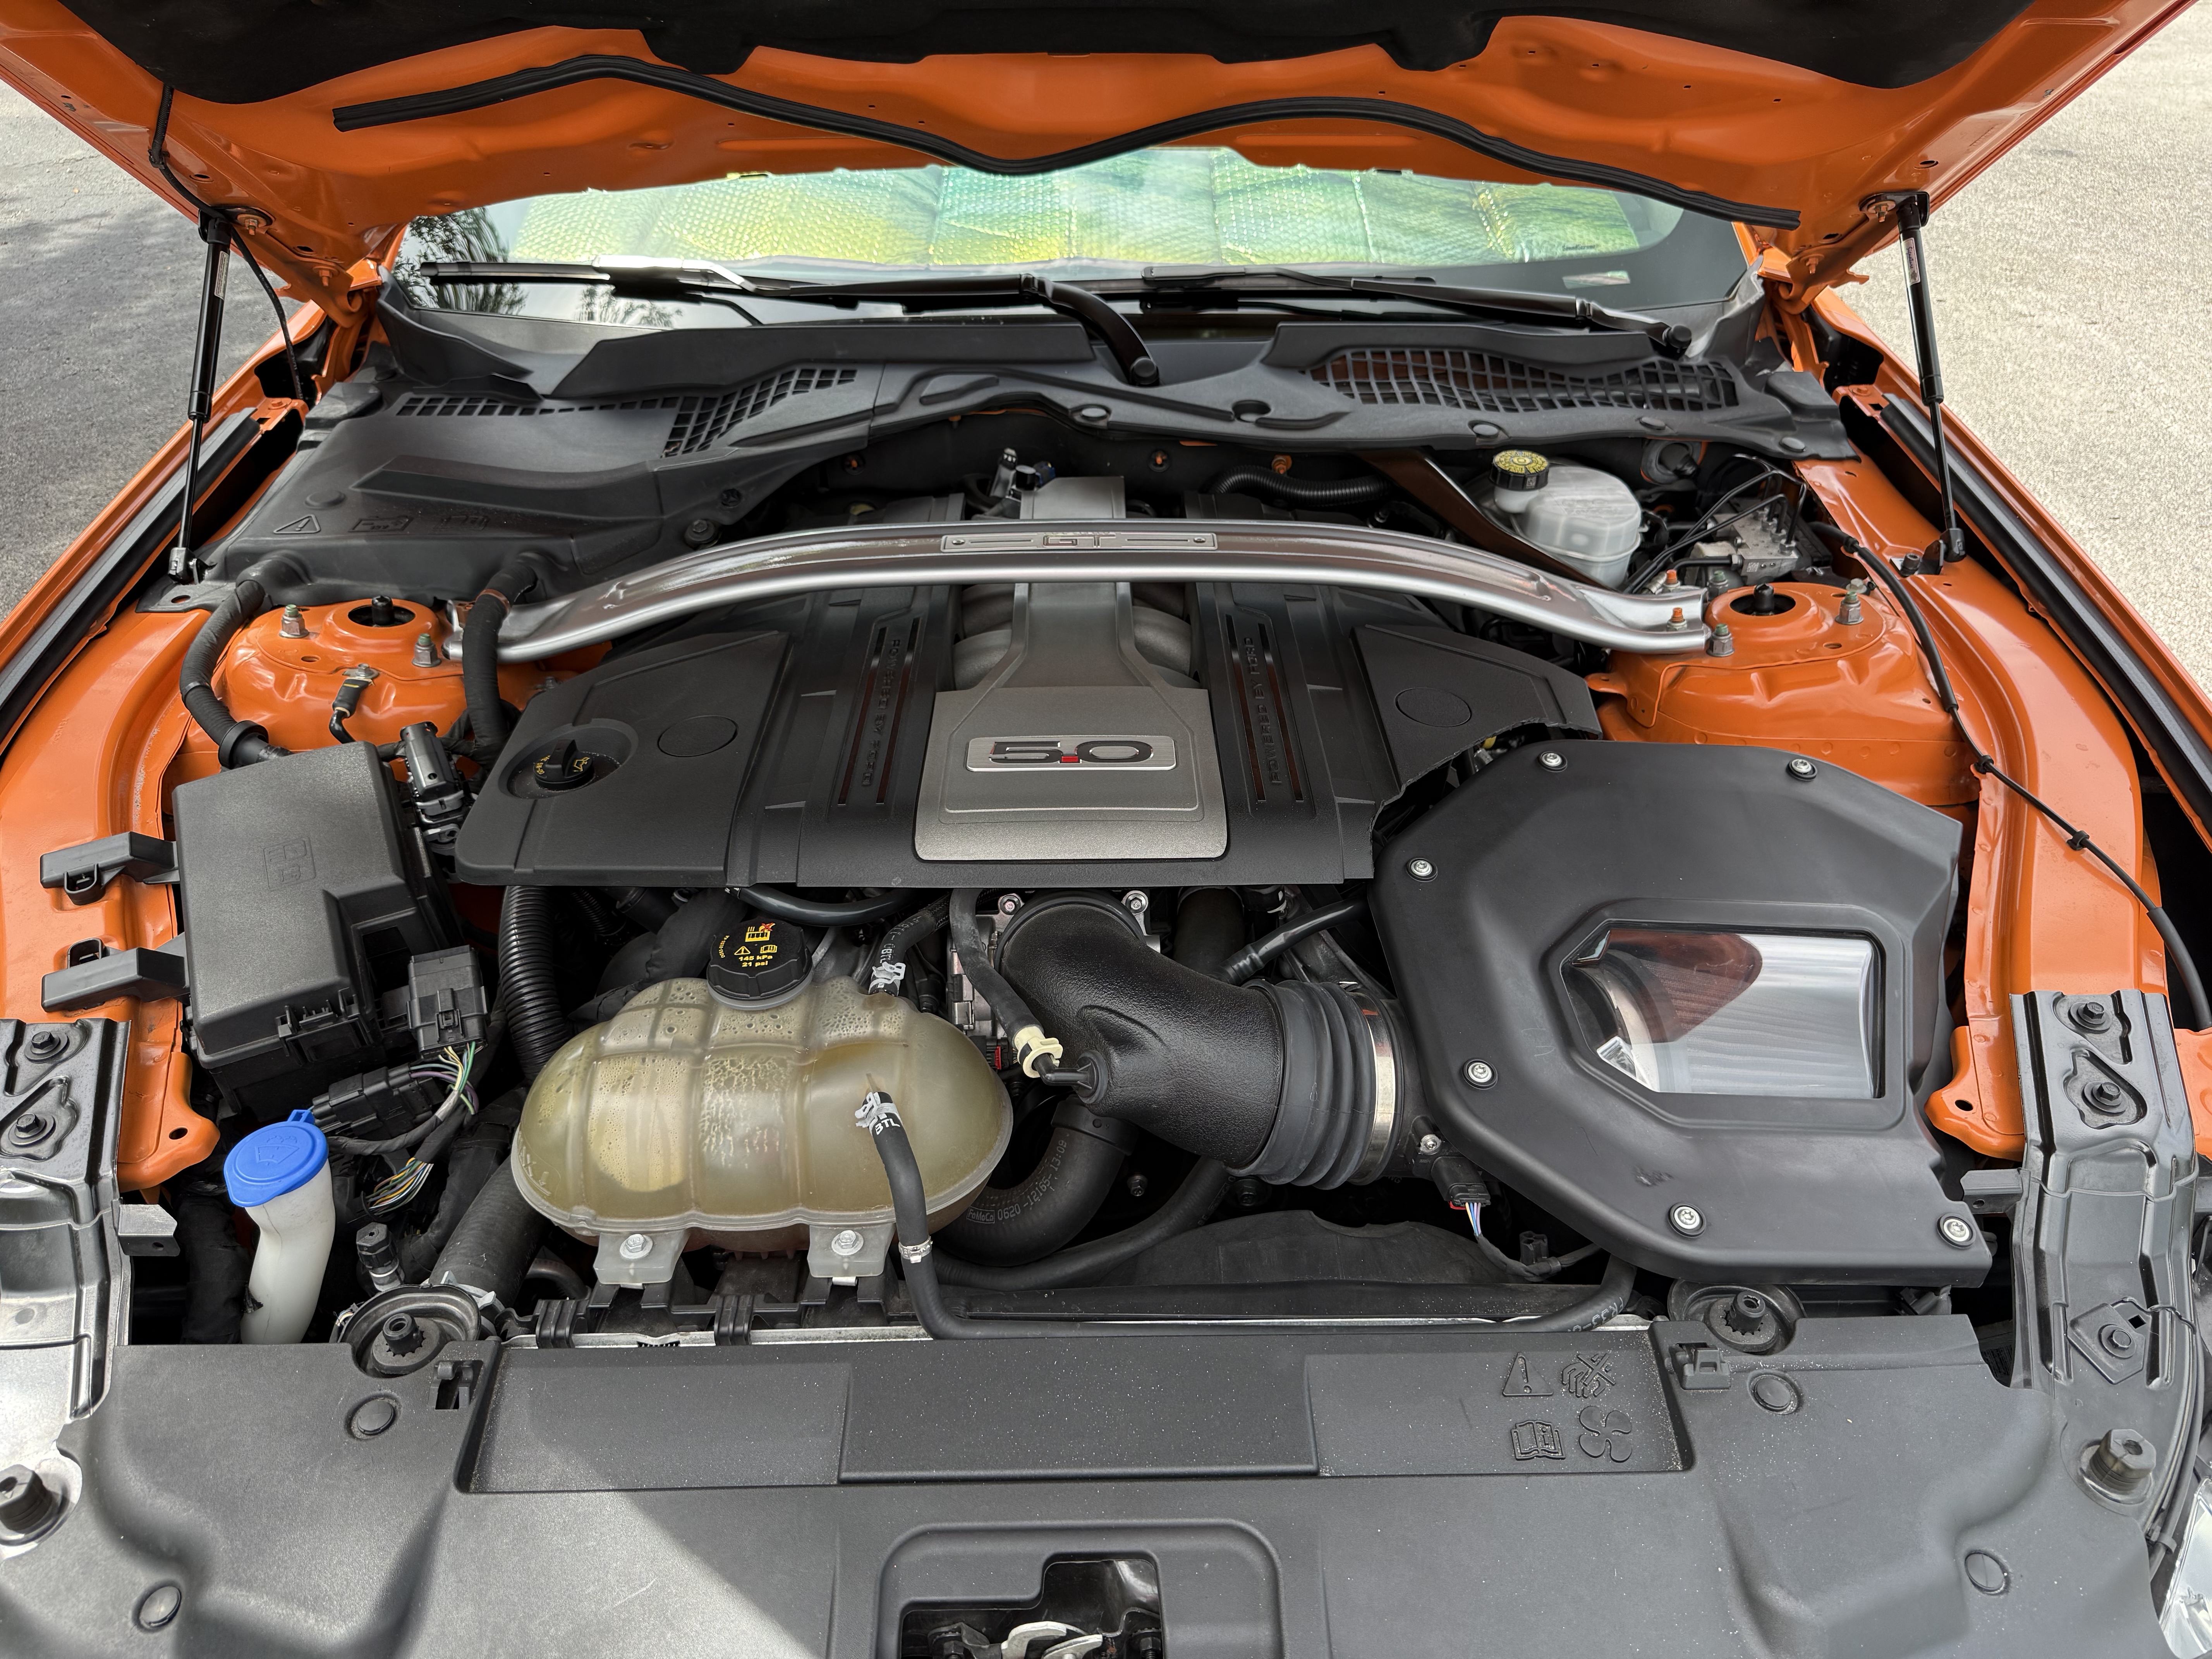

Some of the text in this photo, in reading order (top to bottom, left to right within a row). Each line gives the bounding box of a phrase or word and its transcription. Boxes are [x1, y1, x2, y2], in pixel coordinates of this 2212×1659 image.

[1042, 534, 1116, 548] GT
[1243, 637, 1282, 784] POWERED BY FORD
[874, 713, 887, 735] BY
[861, 739, 881, 786] FORD
[988, 740, 1154, 764] 5.0
[875, 1118, 900, 1135] BTL
[998, 1204, 1021, 1221] 0620
[1050, 1140, 1067, 1171] 13:09
